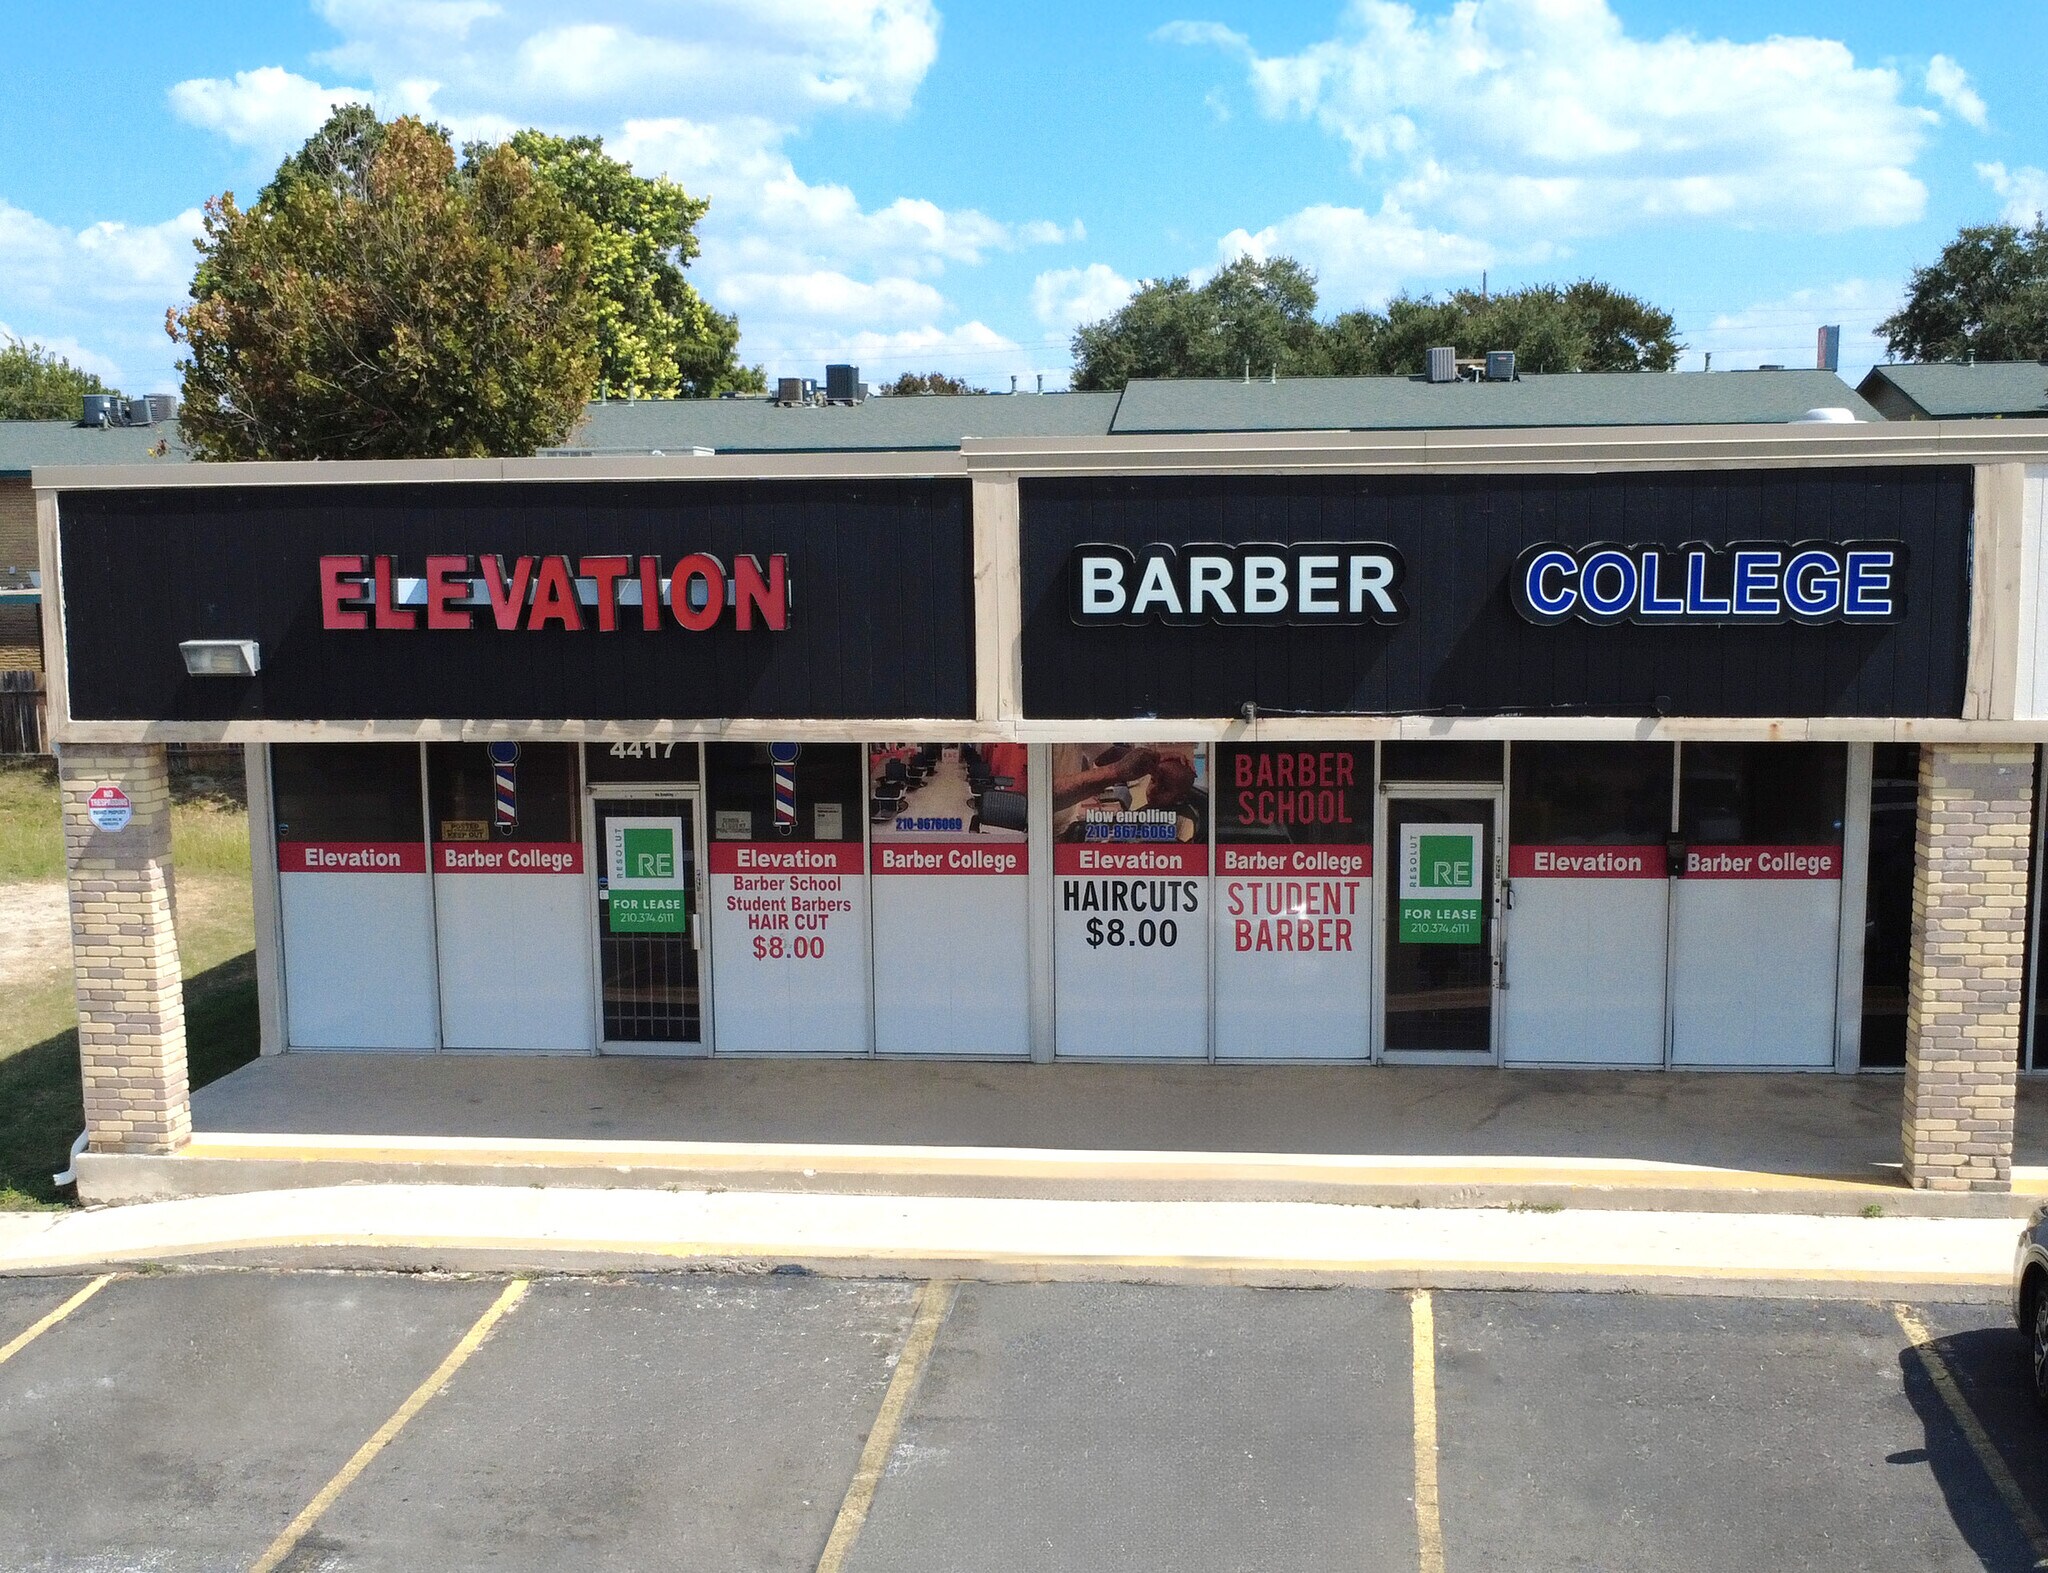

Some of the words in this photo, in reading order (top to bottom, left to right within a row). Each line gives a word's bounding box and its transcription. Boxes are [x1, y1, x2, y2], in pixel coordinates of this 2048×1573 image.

[319, 552, 790, 631] ELEVATION
[1082, 556, 1398, 614] BARBER
[1525, 550, 1893, 616] COLLEGE
[1235, 752, 1354, 788] BARBER
[1086, 809, 1113, 823] Now
[1116, 809, 1177, 824] enrolling
[1238, 790, 1353, 826] SCHOOL
[1086, 825, 1177, 839] 210-867-6069
[305, 848, 400, 867] Elevation
[445, 849, 502, 867] Barber
[507, 849, 573, 872] College
[615, 828, 623, 879] RESOLUT
[638, 853, 672, 877] RE
[737, 849, 837, 868] Elevation
[882, 850, 943, 868] Barber
[948, 850, 1016, 873] College
[1079, 850, 1182, 870] Elevation
[1225, 851, 1286, 870] Barber
[1292, 851, 1363, 875] College
[1409, 835, 1418, 888] RESOLUT
[1534, 852, 1642, 871] Elevation
[1687, 853, 1752, 872] Barber
[1757, 852, 1832, 875] College
[733, 876, 785, 892] Barber
[789, 875, 841, 891] School
[1433, 861, 1471, 885] RE
[613, 900, 638, 910] FOR
[643, 900, 680, 910] LEASE
[727, 896, 786, 912] Student
[791, 896, 852, 912] Barbers
[1063, 880, 1199, 913] HAIRCUTS
[1227, 882, 1360, 916] STUDENT
[620, 913, 674, 923] 210.374.6111
[748, 914, 789, 930] HAIR
[794, 914, 829, 930] CUT
[1404, 909, 1432, 920] FOR
[1436, 909, 1477, 920] LEASE
[1086, 916, 1178, 950] $8.00
[1235, 919, 1353, 953] BARBER
[1411, 922, 1470, 933] 210.374.6111
[753, 935, 825, 961] $8.00
